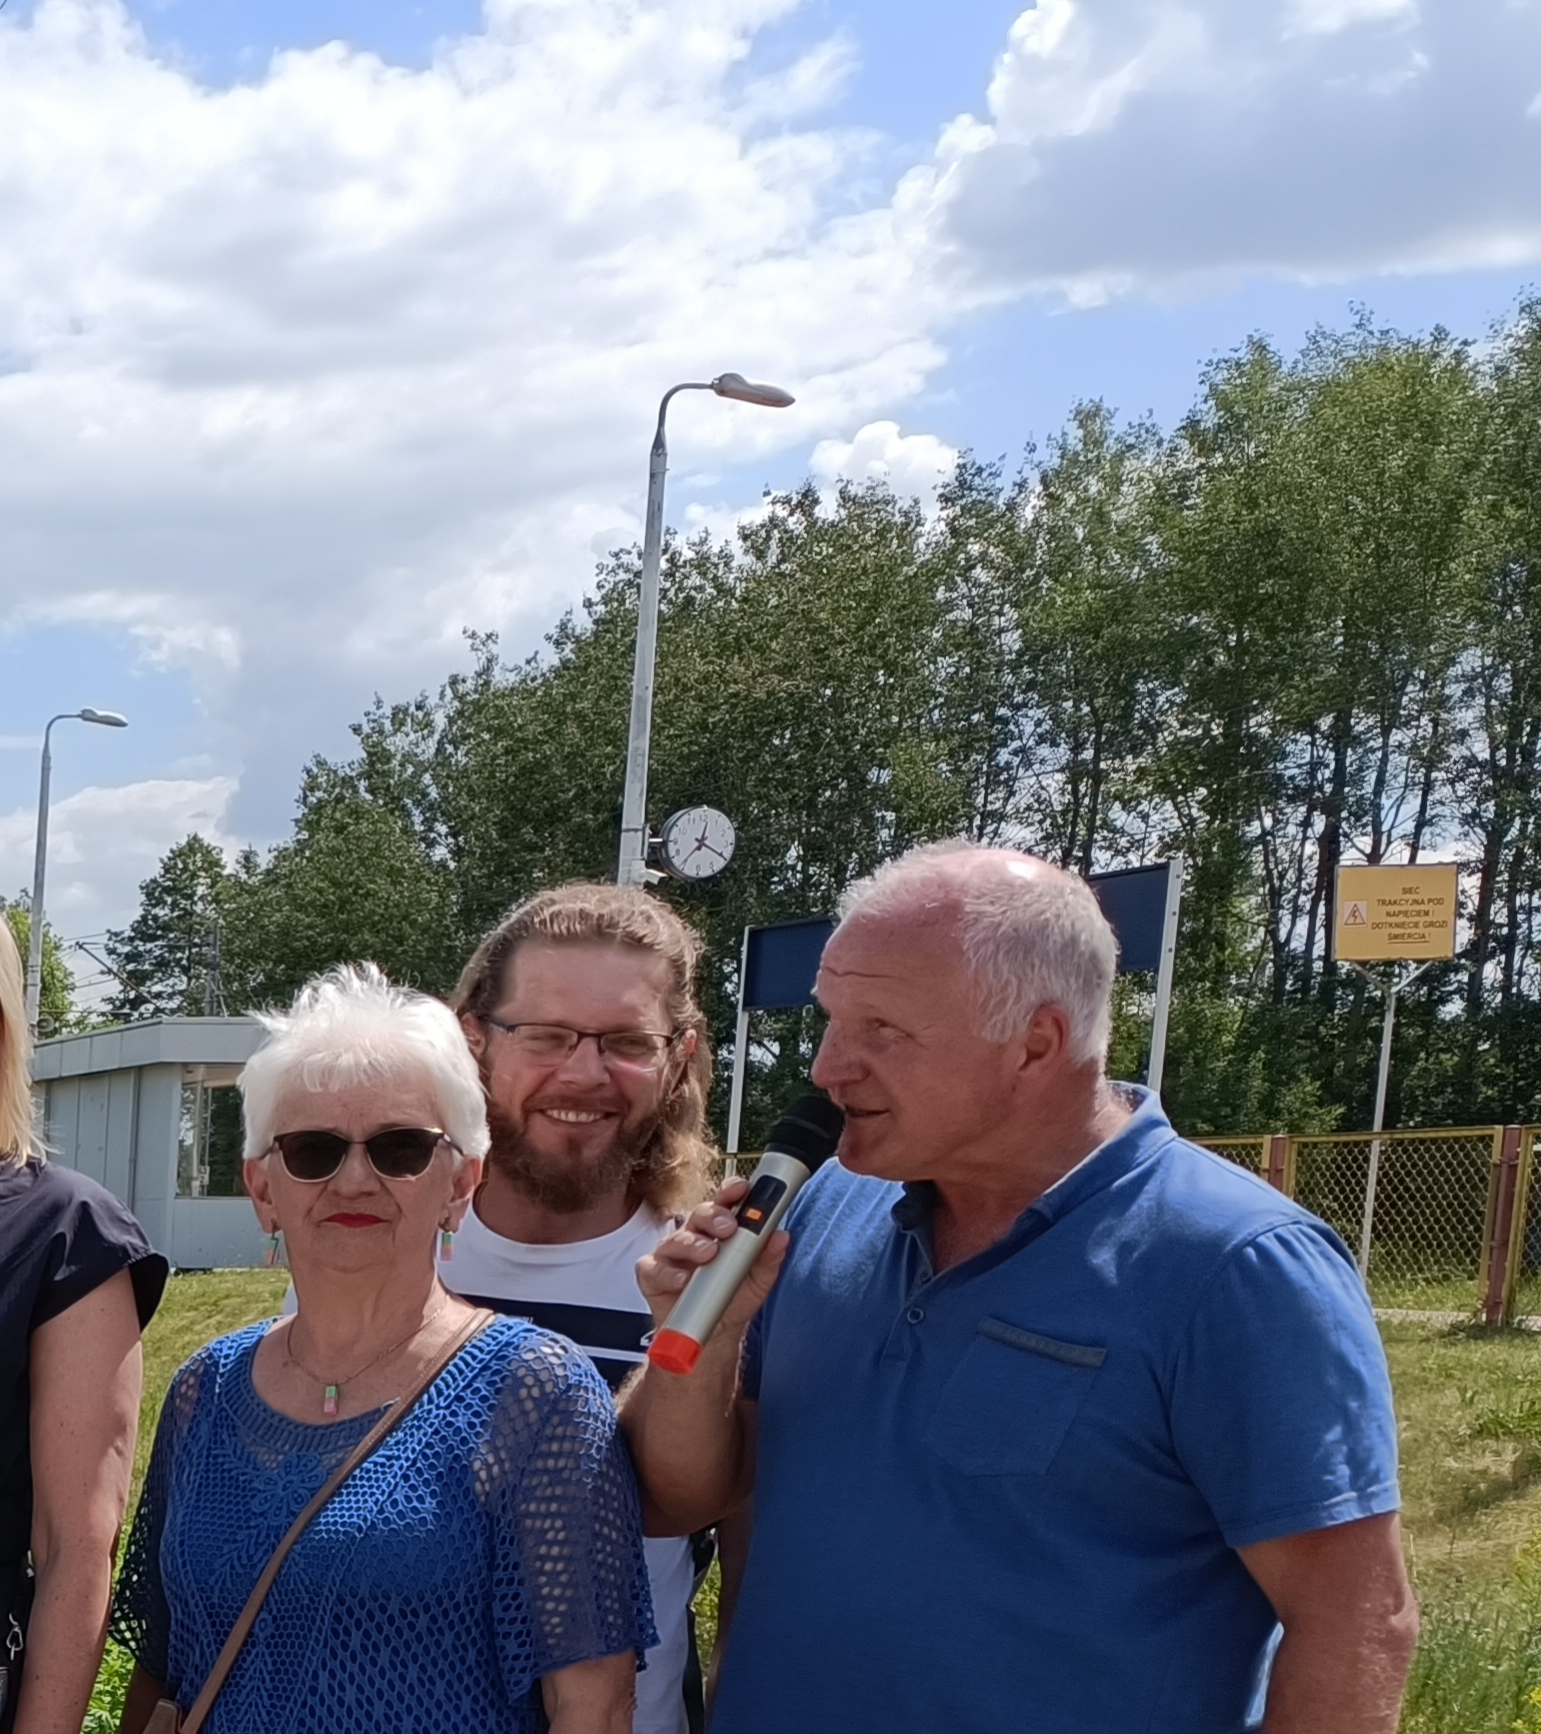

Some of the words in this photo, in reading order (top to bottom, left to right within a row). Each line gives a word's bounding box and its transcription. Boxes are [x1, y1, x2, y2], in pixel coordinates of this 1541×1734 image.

[1376, 898, 1426, 907] TRAKCYJNA
[1426, 898, 1444, 906] POD
[1422, 920, 1448, 928] GROZI
